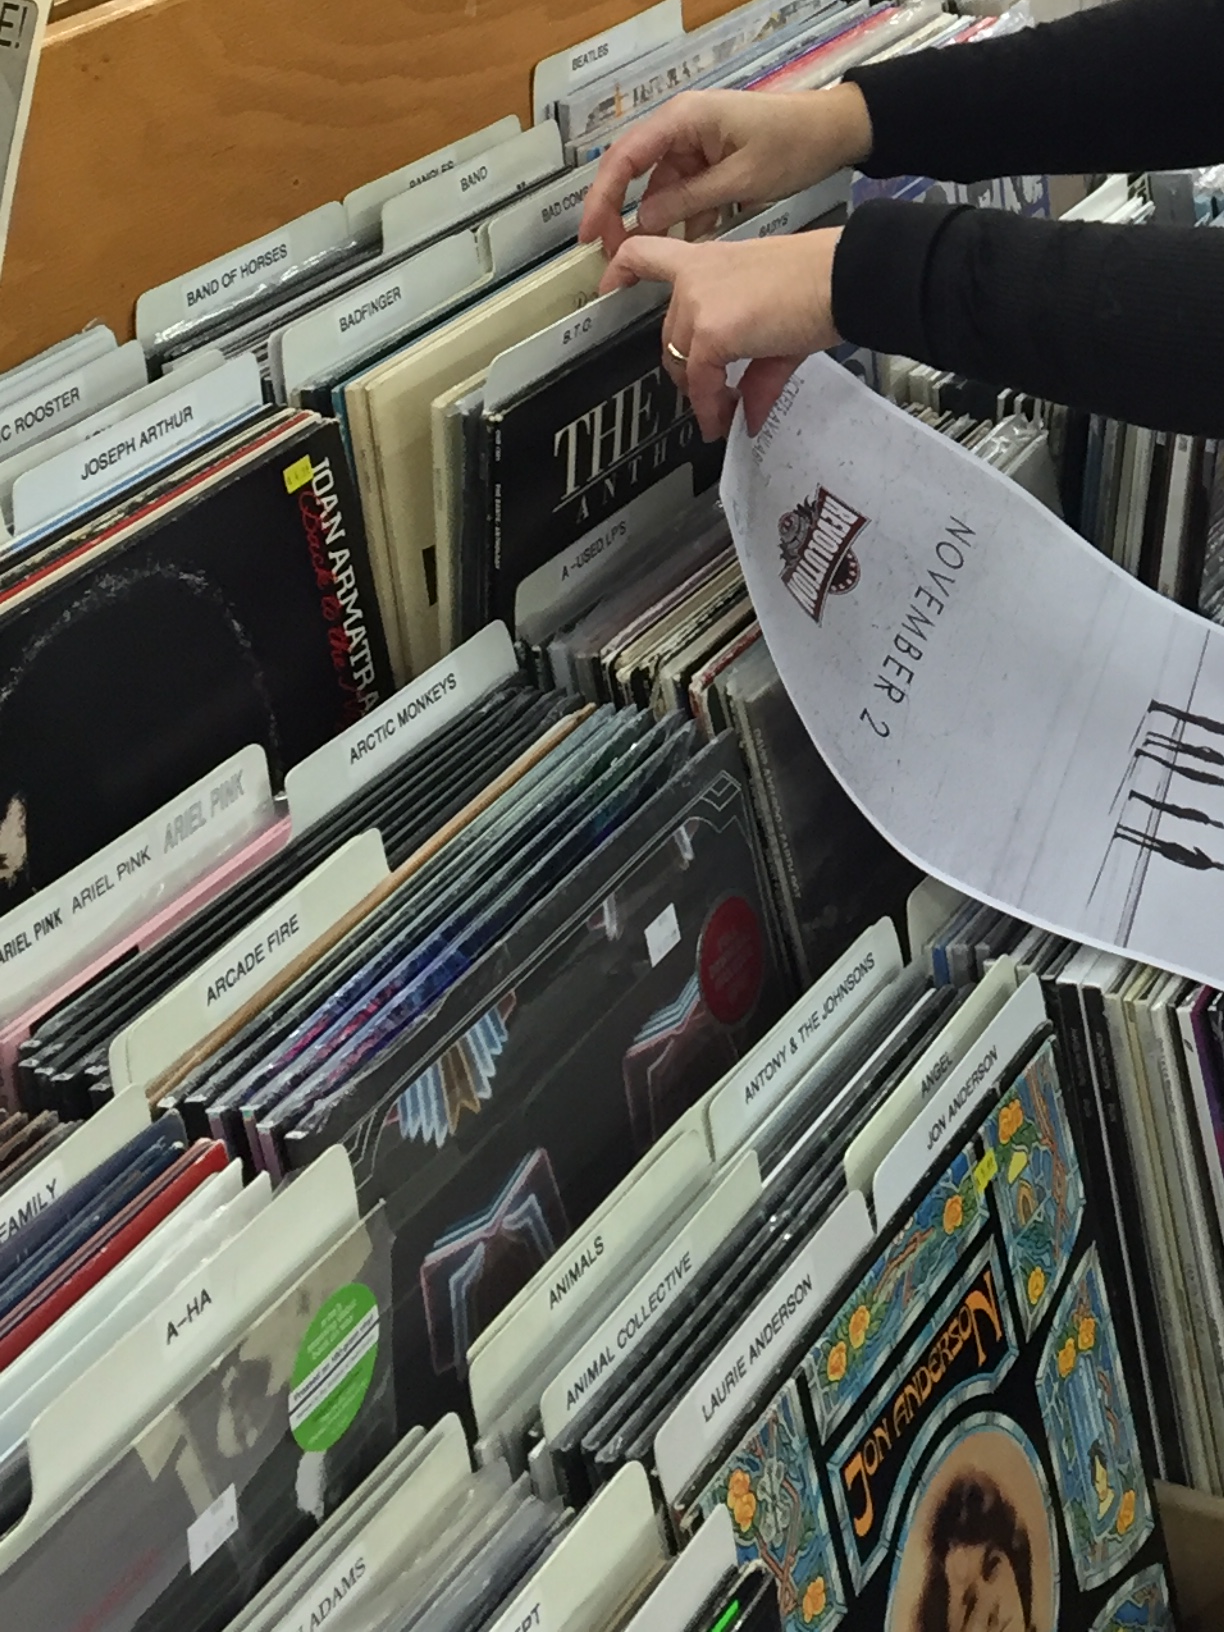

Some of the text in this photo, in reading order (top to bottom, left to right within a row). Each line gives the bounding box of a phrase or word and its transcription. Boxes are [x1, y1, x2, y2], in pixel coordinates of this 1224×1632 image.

[571, 42, 609, 71] BEATLES
[459, 165, 489, 193] BAND
[541, 199, 563, 224] BAD
[186, 243, 289, 308] BAND OF HORSES
[338, 286, 402, 333] BADFINGER
[14, 386, 82, 436] ROOSTER
[81, 404, 195, 481] JOSEPH ARTHUR
[786, 494, 859, 616] REVOLUTION
[859, 515, 977, 739] NOVEMBER 2
[348, 672, 458, 765] ARCTIC MONKEYS
[33, 908, 63, 948] PINK
[71, 876, 116, 915] ARIEL
[115, 844, 152, 883] PINK
[162, 810, 207, 855] ARIEL
[207, 769, 246, 820] PINK
[205, 913, 300, 1007] ARCADE FIRE
[741, 950, 877, 1106] ANTONY & THE JOHNSONS
[919, 1051, 955, 1099] ANGEL
[925, 1043, 1001, 1153] JON ANDERSON
[547, 1234, 607, 1311] ANIMALS
[165, 1288, 213, 1346] A-HA
[565, 1250, 694, 1411] ANIMAL COLLECTIVE
[700, 1273, 816, 1425] LAURIE ANDERSON
[843, 1270, 1004, 1538] JON ANDERSON
[304, 1556, 368, 1632] ADAMS
